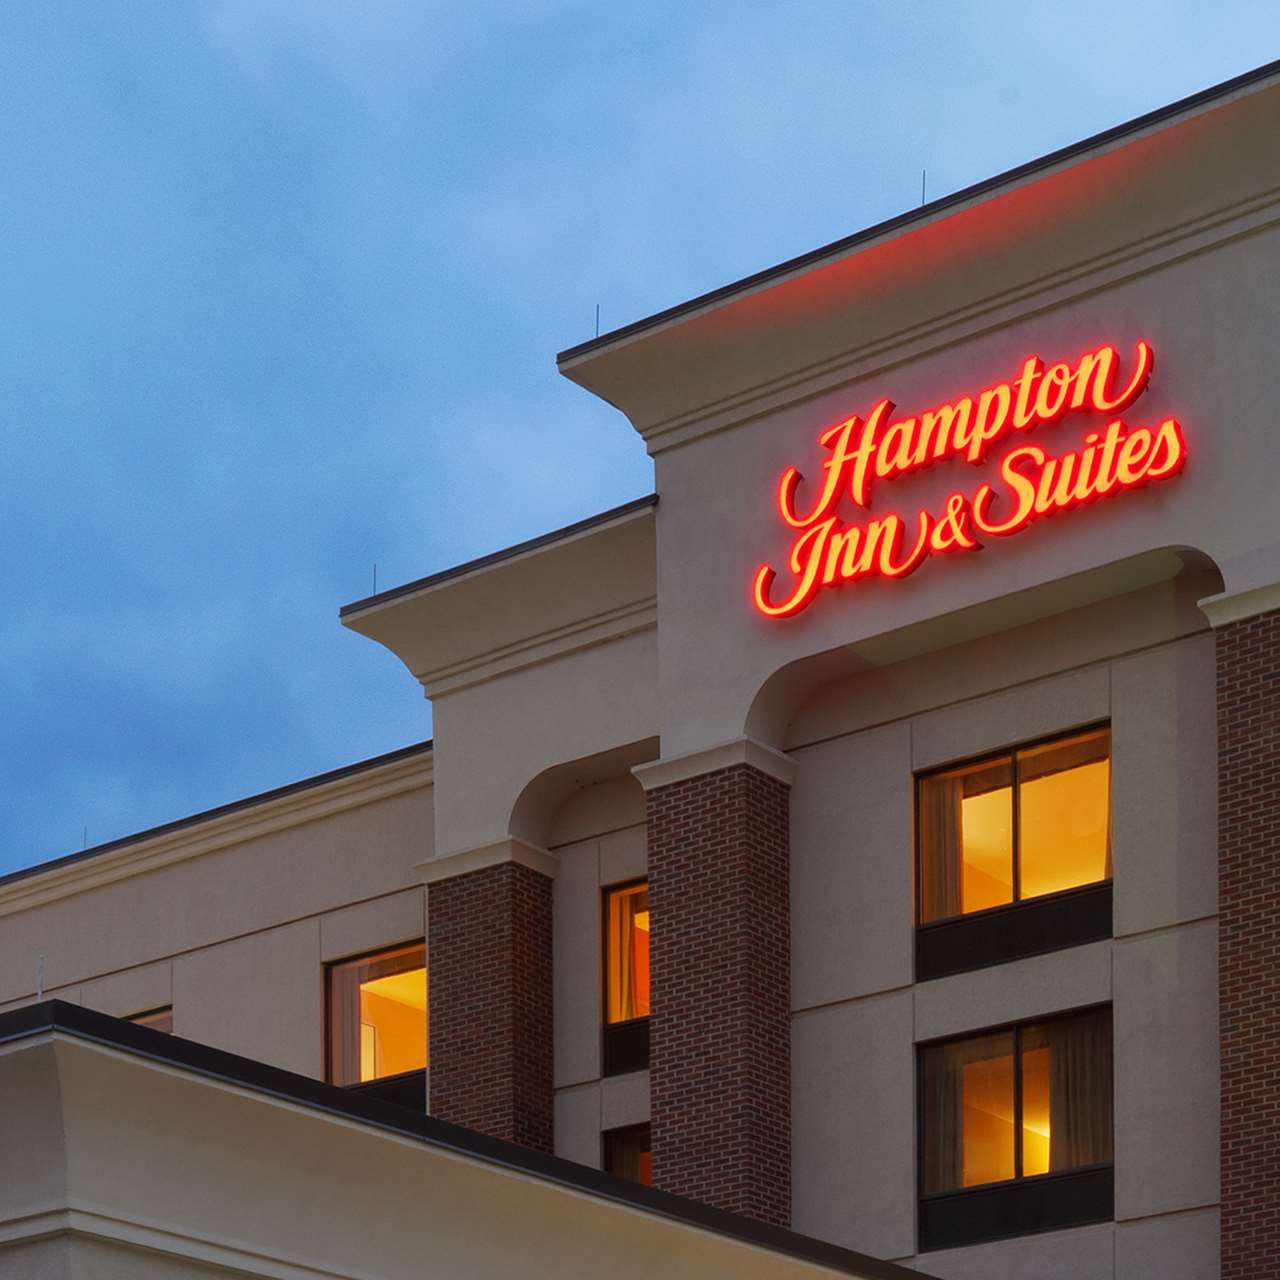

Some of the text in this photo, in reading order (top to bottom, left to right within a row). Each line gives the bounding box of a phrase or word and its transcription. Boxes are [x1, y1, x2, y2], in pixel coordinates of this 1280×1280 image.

[753, 419, 1185, 618] Inn & Suites
[779, 340, 1153, 528] Hampton
